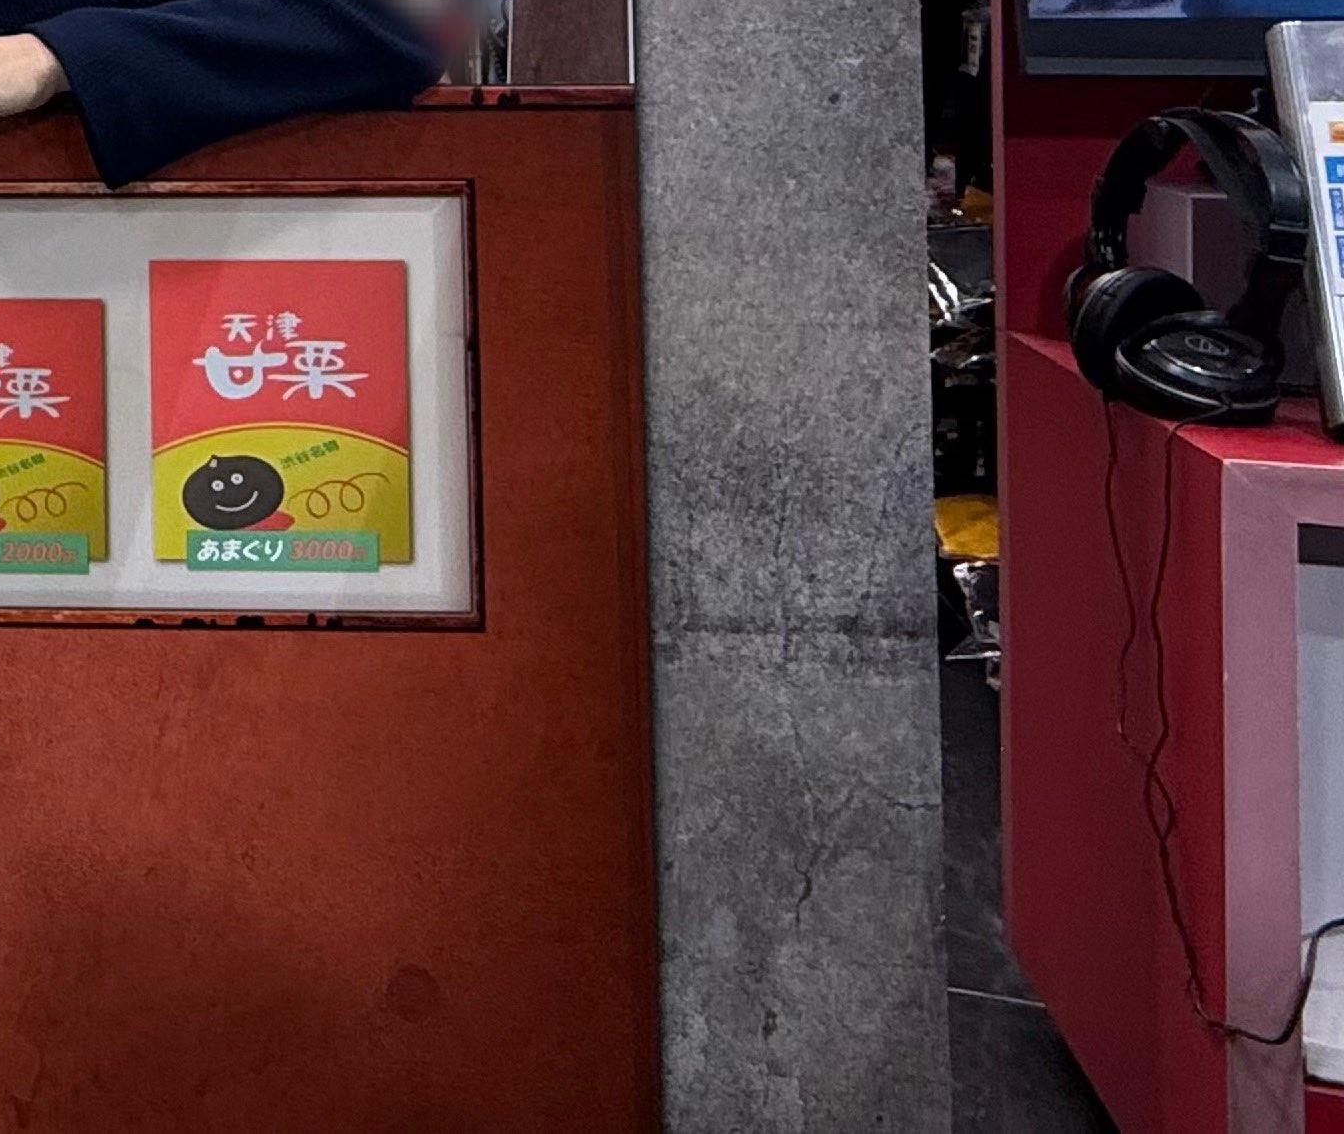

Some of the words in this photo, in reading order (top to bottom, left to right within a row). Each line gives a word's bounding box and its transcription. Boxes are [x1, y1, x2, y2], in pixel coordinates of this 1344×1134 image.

[221, 311, 302, 343] 天津
[191, 339, 370, 400] 甘栗
[196, 538, 284, 562] あまぐり
